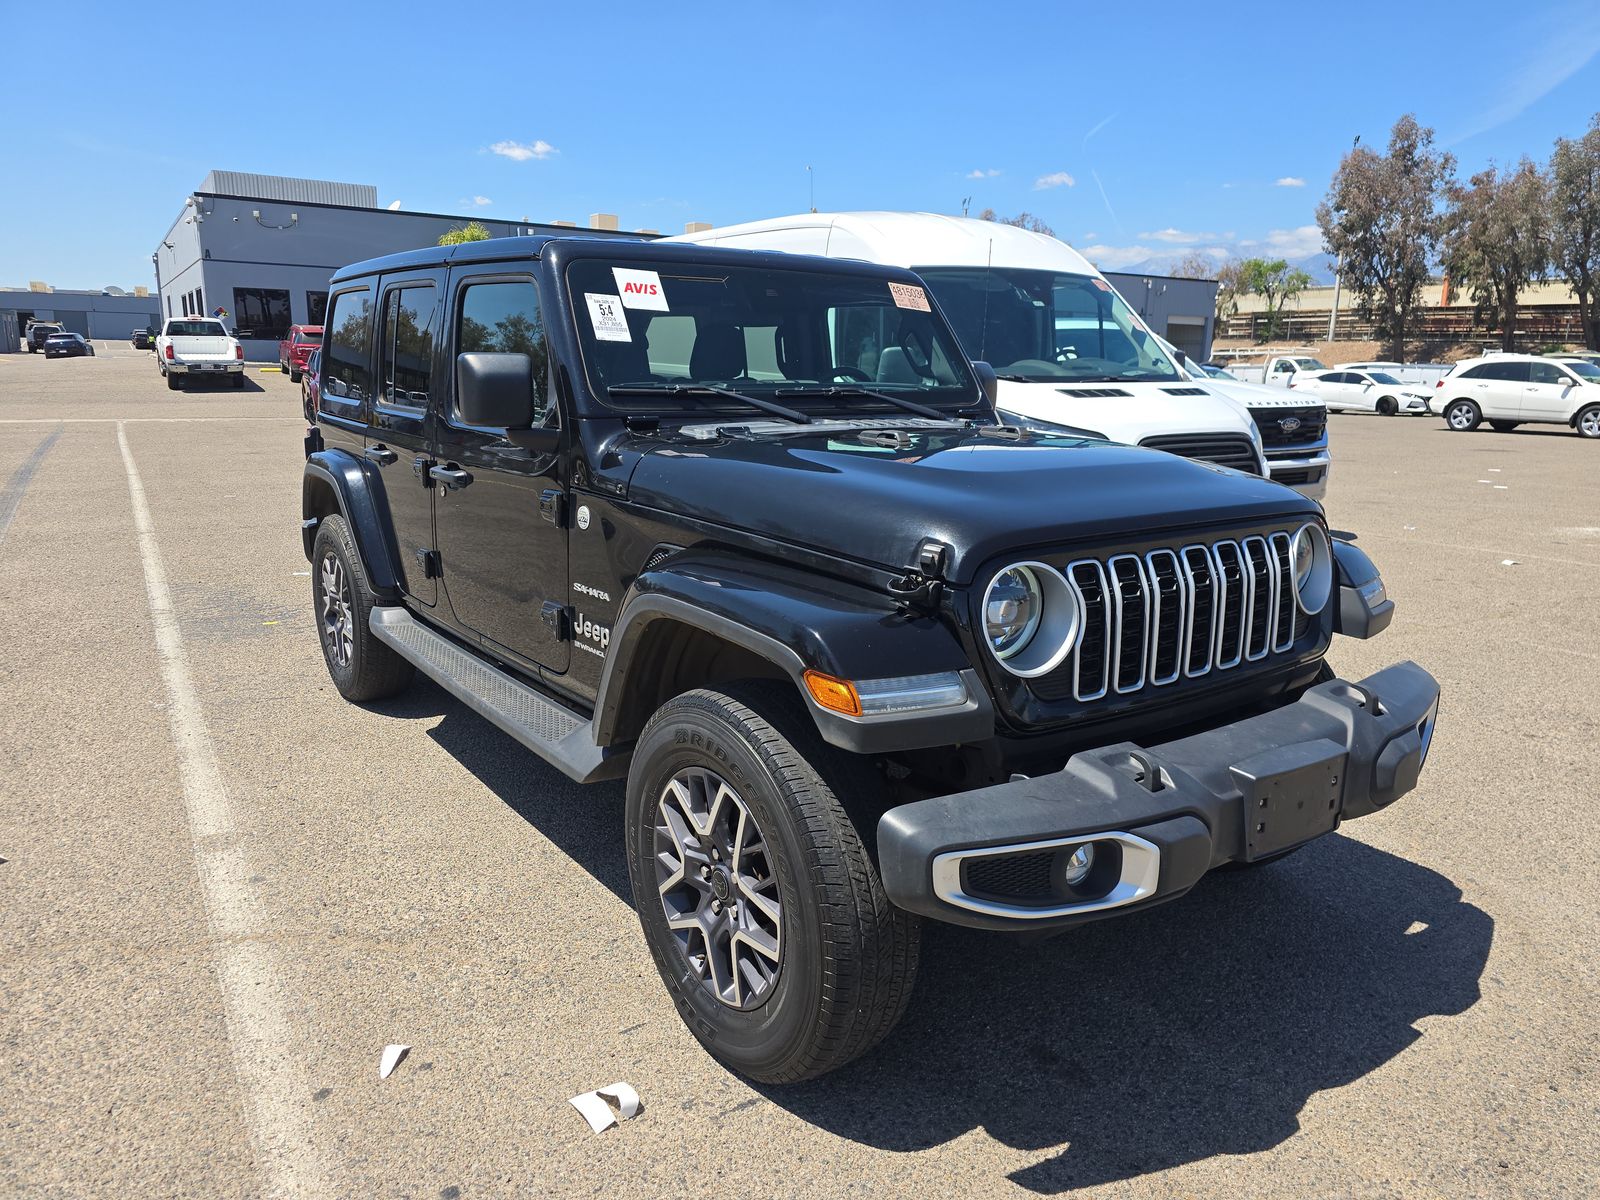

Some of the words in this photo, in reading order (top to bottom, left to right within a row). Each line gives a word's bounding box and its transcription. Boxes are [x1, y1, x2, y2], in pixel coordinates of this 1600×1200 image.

[205, 248, 212, 259] A
[624, 282, 657, 295] AVIS
[599, 303, 614, 317] 5:4
[573, 582, 611, 602] SAHARA
[573, 612, 610, 649] Jeep
[579, 642, 606, 658] WRANGL
